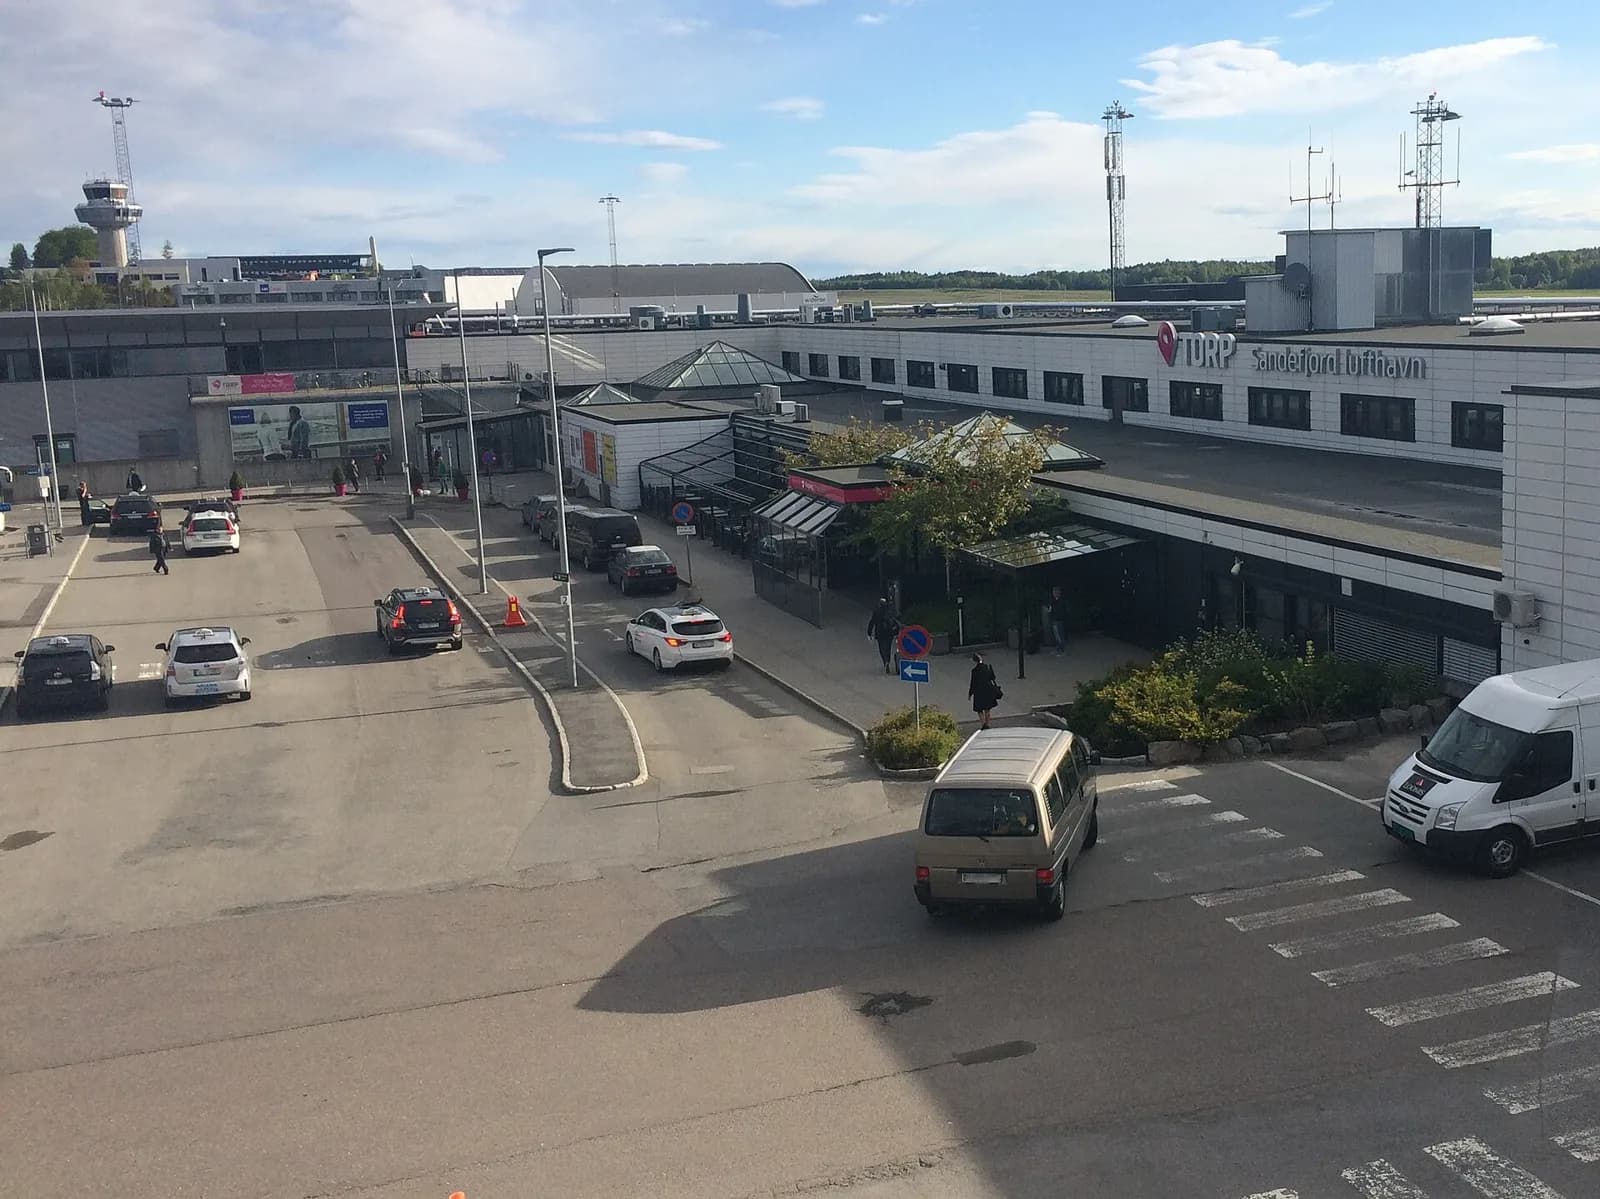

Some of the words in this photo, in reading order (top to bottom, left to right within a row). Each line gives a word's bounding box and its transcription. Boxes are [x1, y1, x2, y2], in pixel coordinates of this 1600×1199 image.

[1179, 332, 1236, 368] TORP
[1252, 346, 1340, 377] Sandefjord
[1345, 349, 1427, 380] lufthavn
